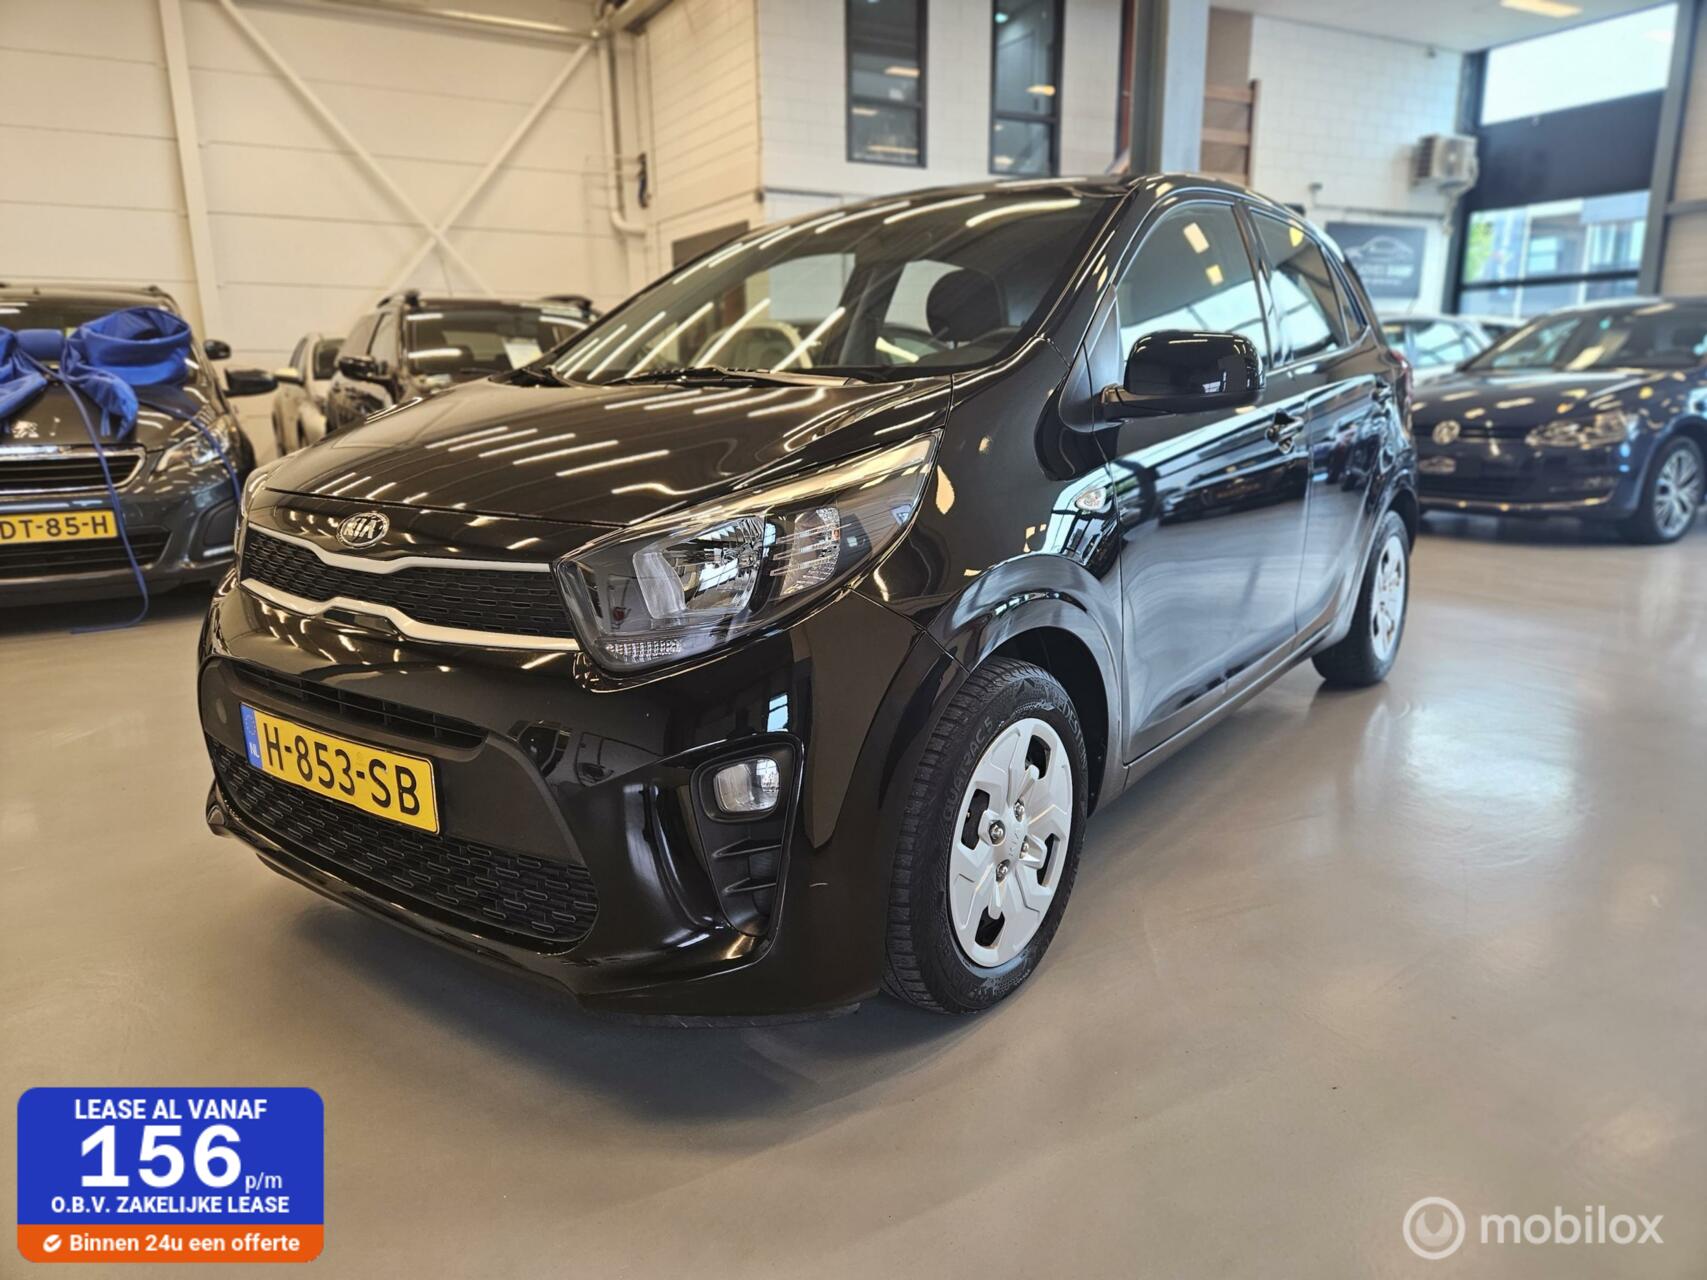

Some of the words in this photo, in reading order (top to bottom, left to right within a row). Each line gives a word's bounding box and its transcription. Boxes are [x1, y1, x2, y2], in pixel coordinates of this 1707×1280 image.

[0, 515, 108, 540] DT-85-H
[343, 517, 377, 539] KIA
[249, 742, 260, 758] NL
[263, 722, 420, 816] H-853-SB
